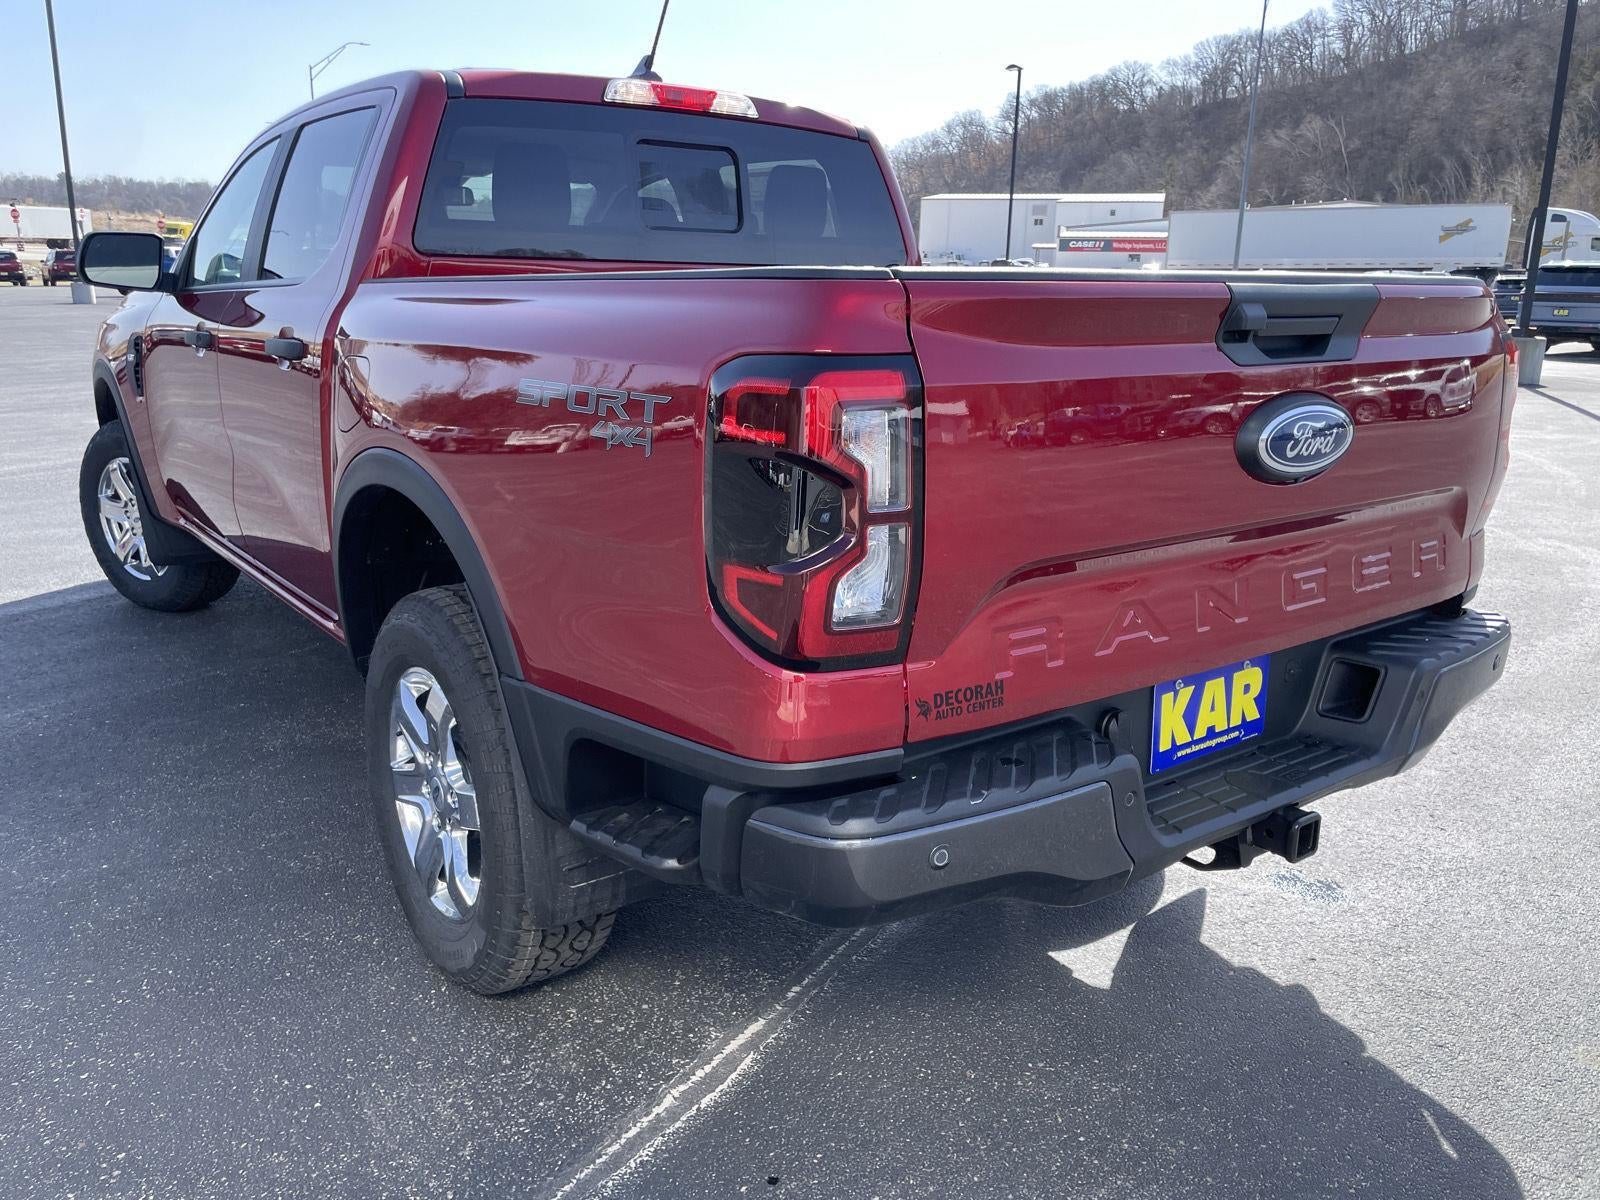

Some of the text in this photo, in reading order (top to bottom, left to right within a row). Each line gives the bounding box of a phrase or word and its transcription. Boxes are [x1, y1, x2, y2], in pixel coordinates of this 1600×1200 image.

[1069, 240, 1095, 248] CASE
[516, 378, 672, 424] SPORT
[1286, 421, 1336, 458] Ford
[993, 533, 1447, 680] RANGER
[933, 680, 1004, 709] DECORAH
[935, 696, 1004, 720] AUTO CENTER
[1159, 667, 1263, 753] KAR
[1177, 731, 1240, 757] www.karautogroup.com
